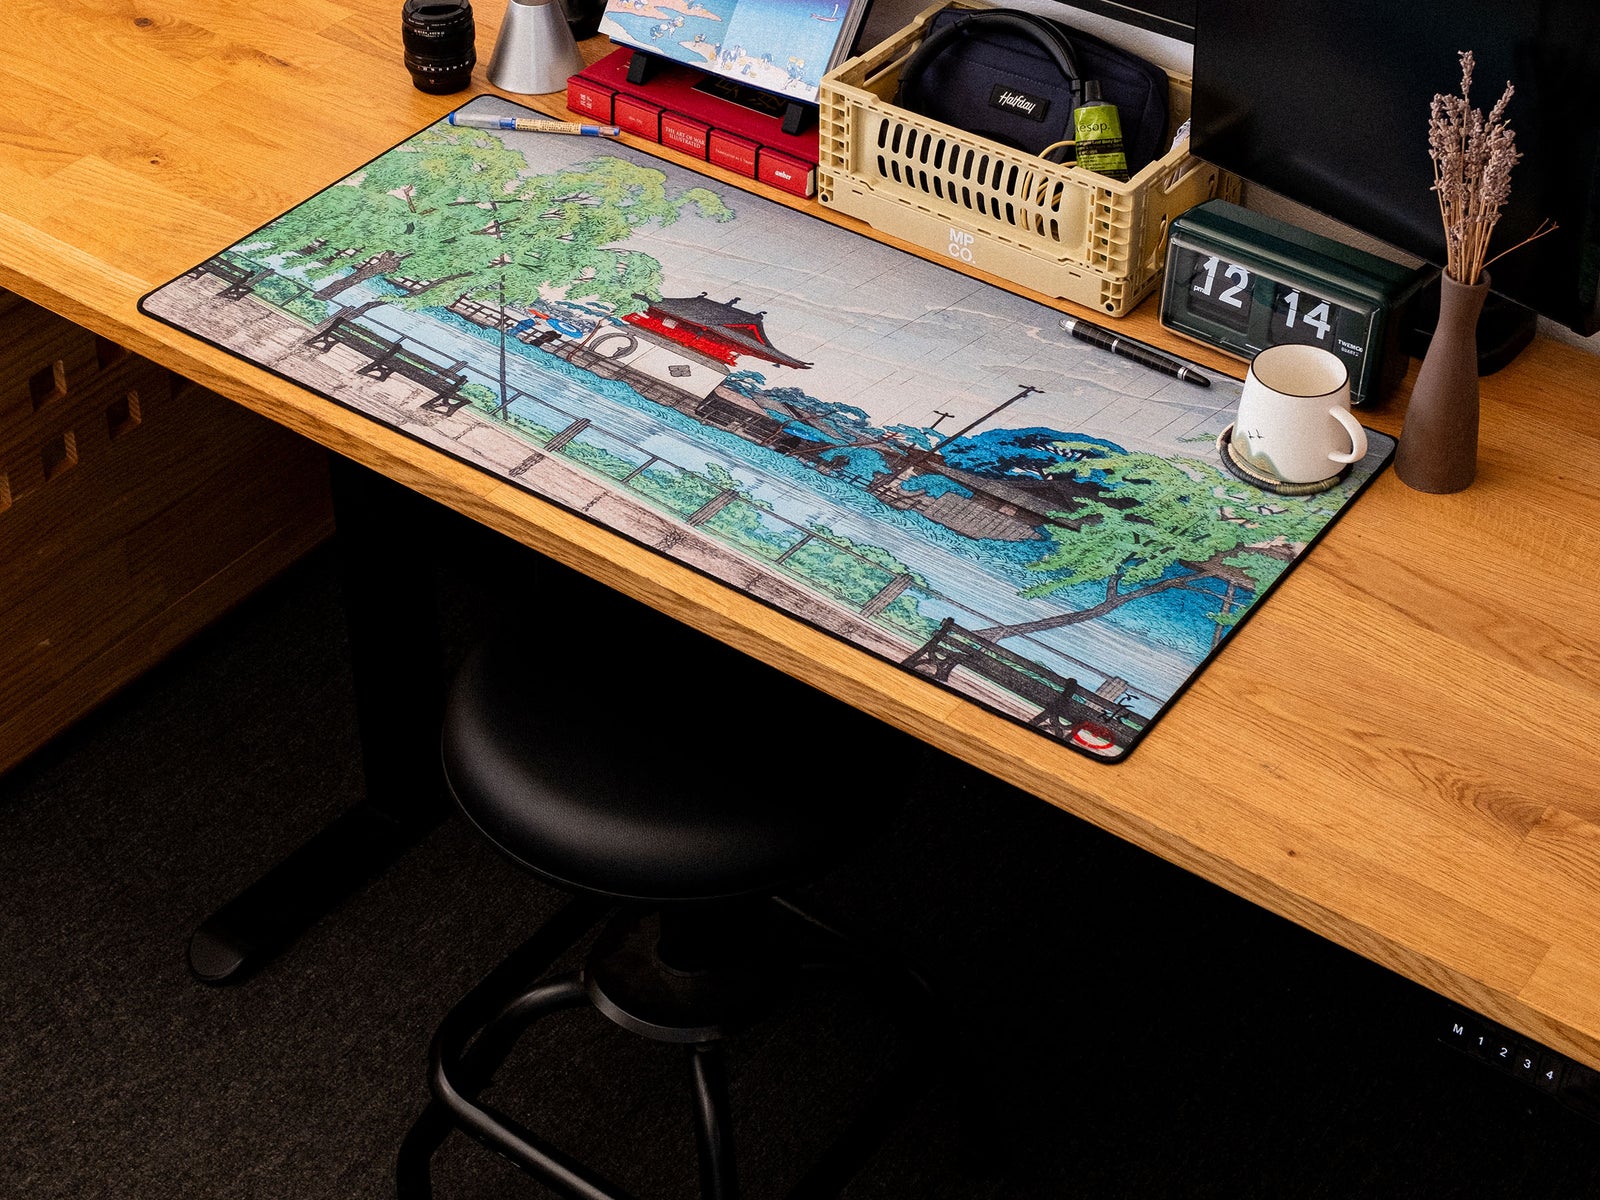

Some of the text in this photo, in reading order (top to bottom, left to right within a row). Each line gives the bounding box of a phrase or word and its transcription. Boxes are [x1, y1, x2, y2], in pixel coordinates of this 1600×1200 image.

[998, 91, 1036, 114] Halfday
[665, 126, 705, 146] THE ART OF WAR
[669, 133, 701, 149] ILLUSTRATED
[774, 170, 792, 181] amber
[949, 227, 975, 247] MP
[948, 243, 976, 264] CO.
[1203, 256, 1331, 340] 12 14
[1337, 339, 1363, 353] TWEMCO
[1453, 1023, 1554, 1080] M 1 2 3 4
